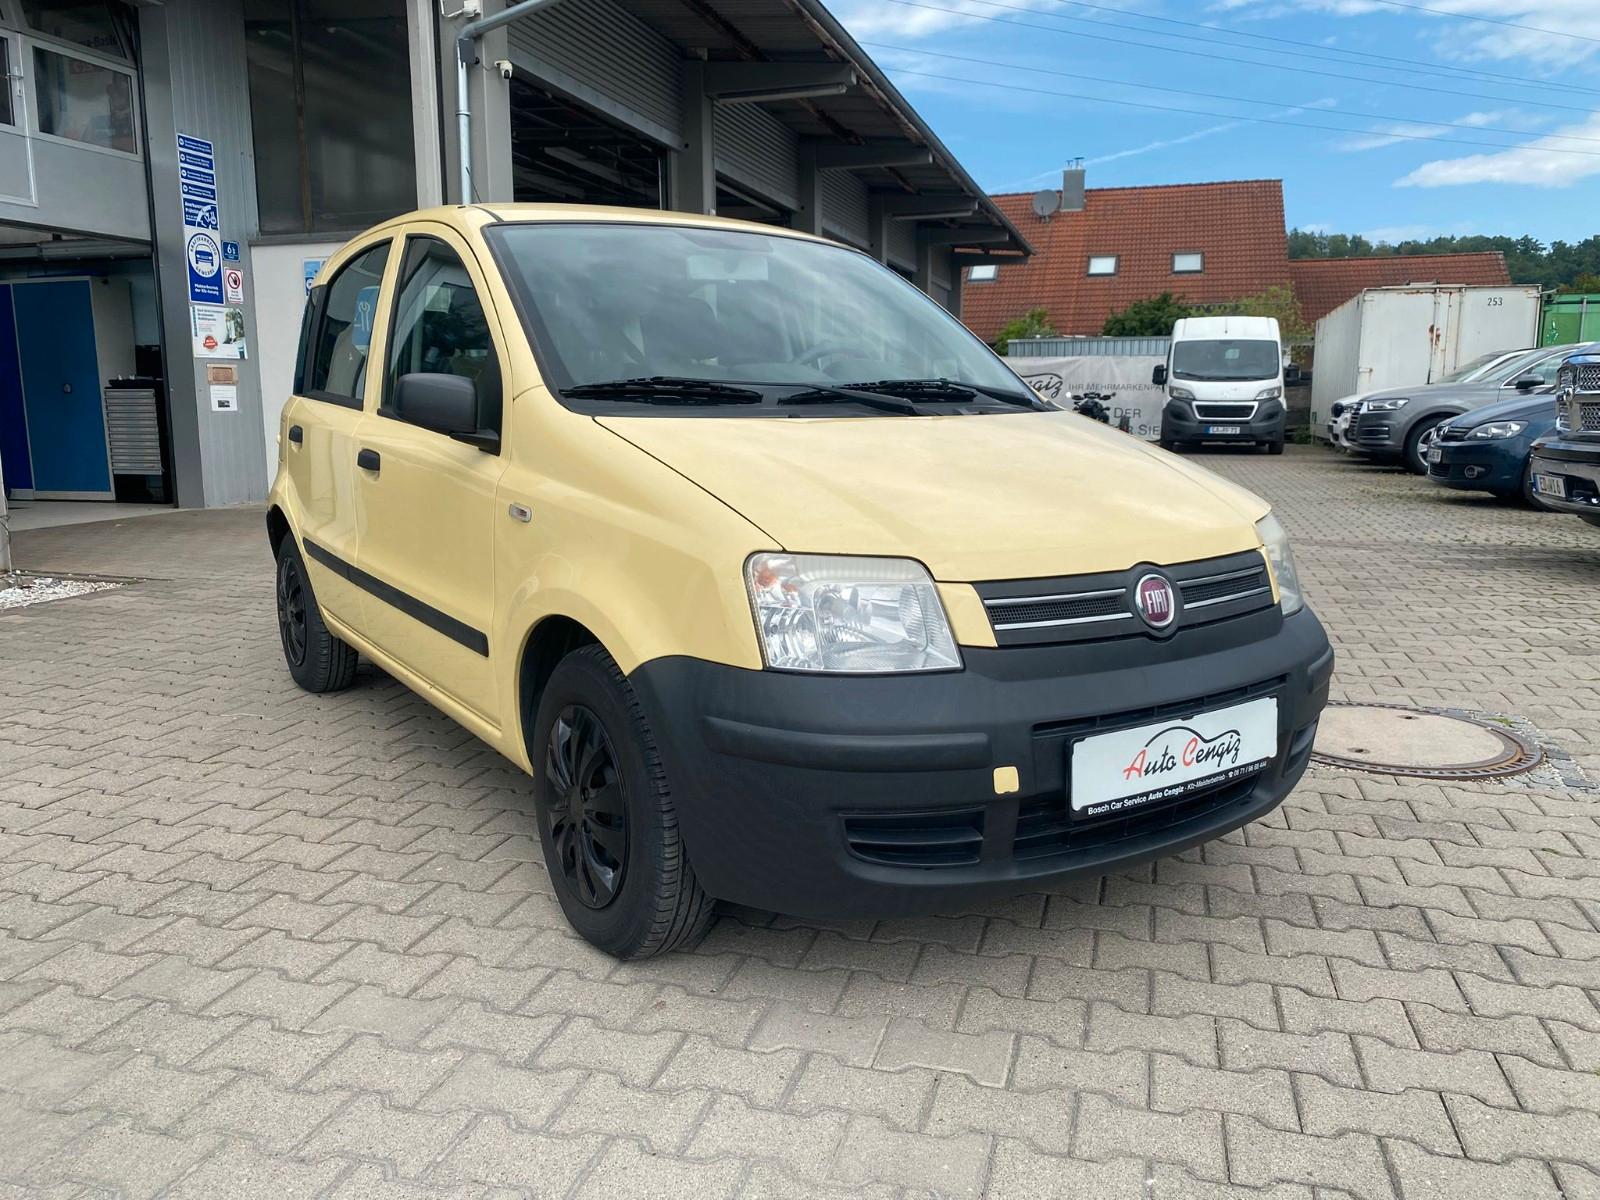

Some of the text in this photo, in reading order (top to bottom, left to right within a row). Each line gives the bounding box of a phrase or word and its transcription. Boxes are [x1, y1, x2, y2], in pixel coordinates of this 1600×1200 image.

[1487, 297, 1503, 306] 253
[1068, 383, 1084, 392] IHR
[1114, 407, 1141, 419] DER
[1144, 589, 1168, 614] FIAT
[1124, 735, 1241, 780] Auto Cengiz
[1088, 804, 1110, 815] Bosch
[1110, 801, 1123, 810] Car
[1123, 796, 1147, 807] Service
[1148, 791, 1163, 801] Auto
[1163, 785, 1184, 797] Cengiz
